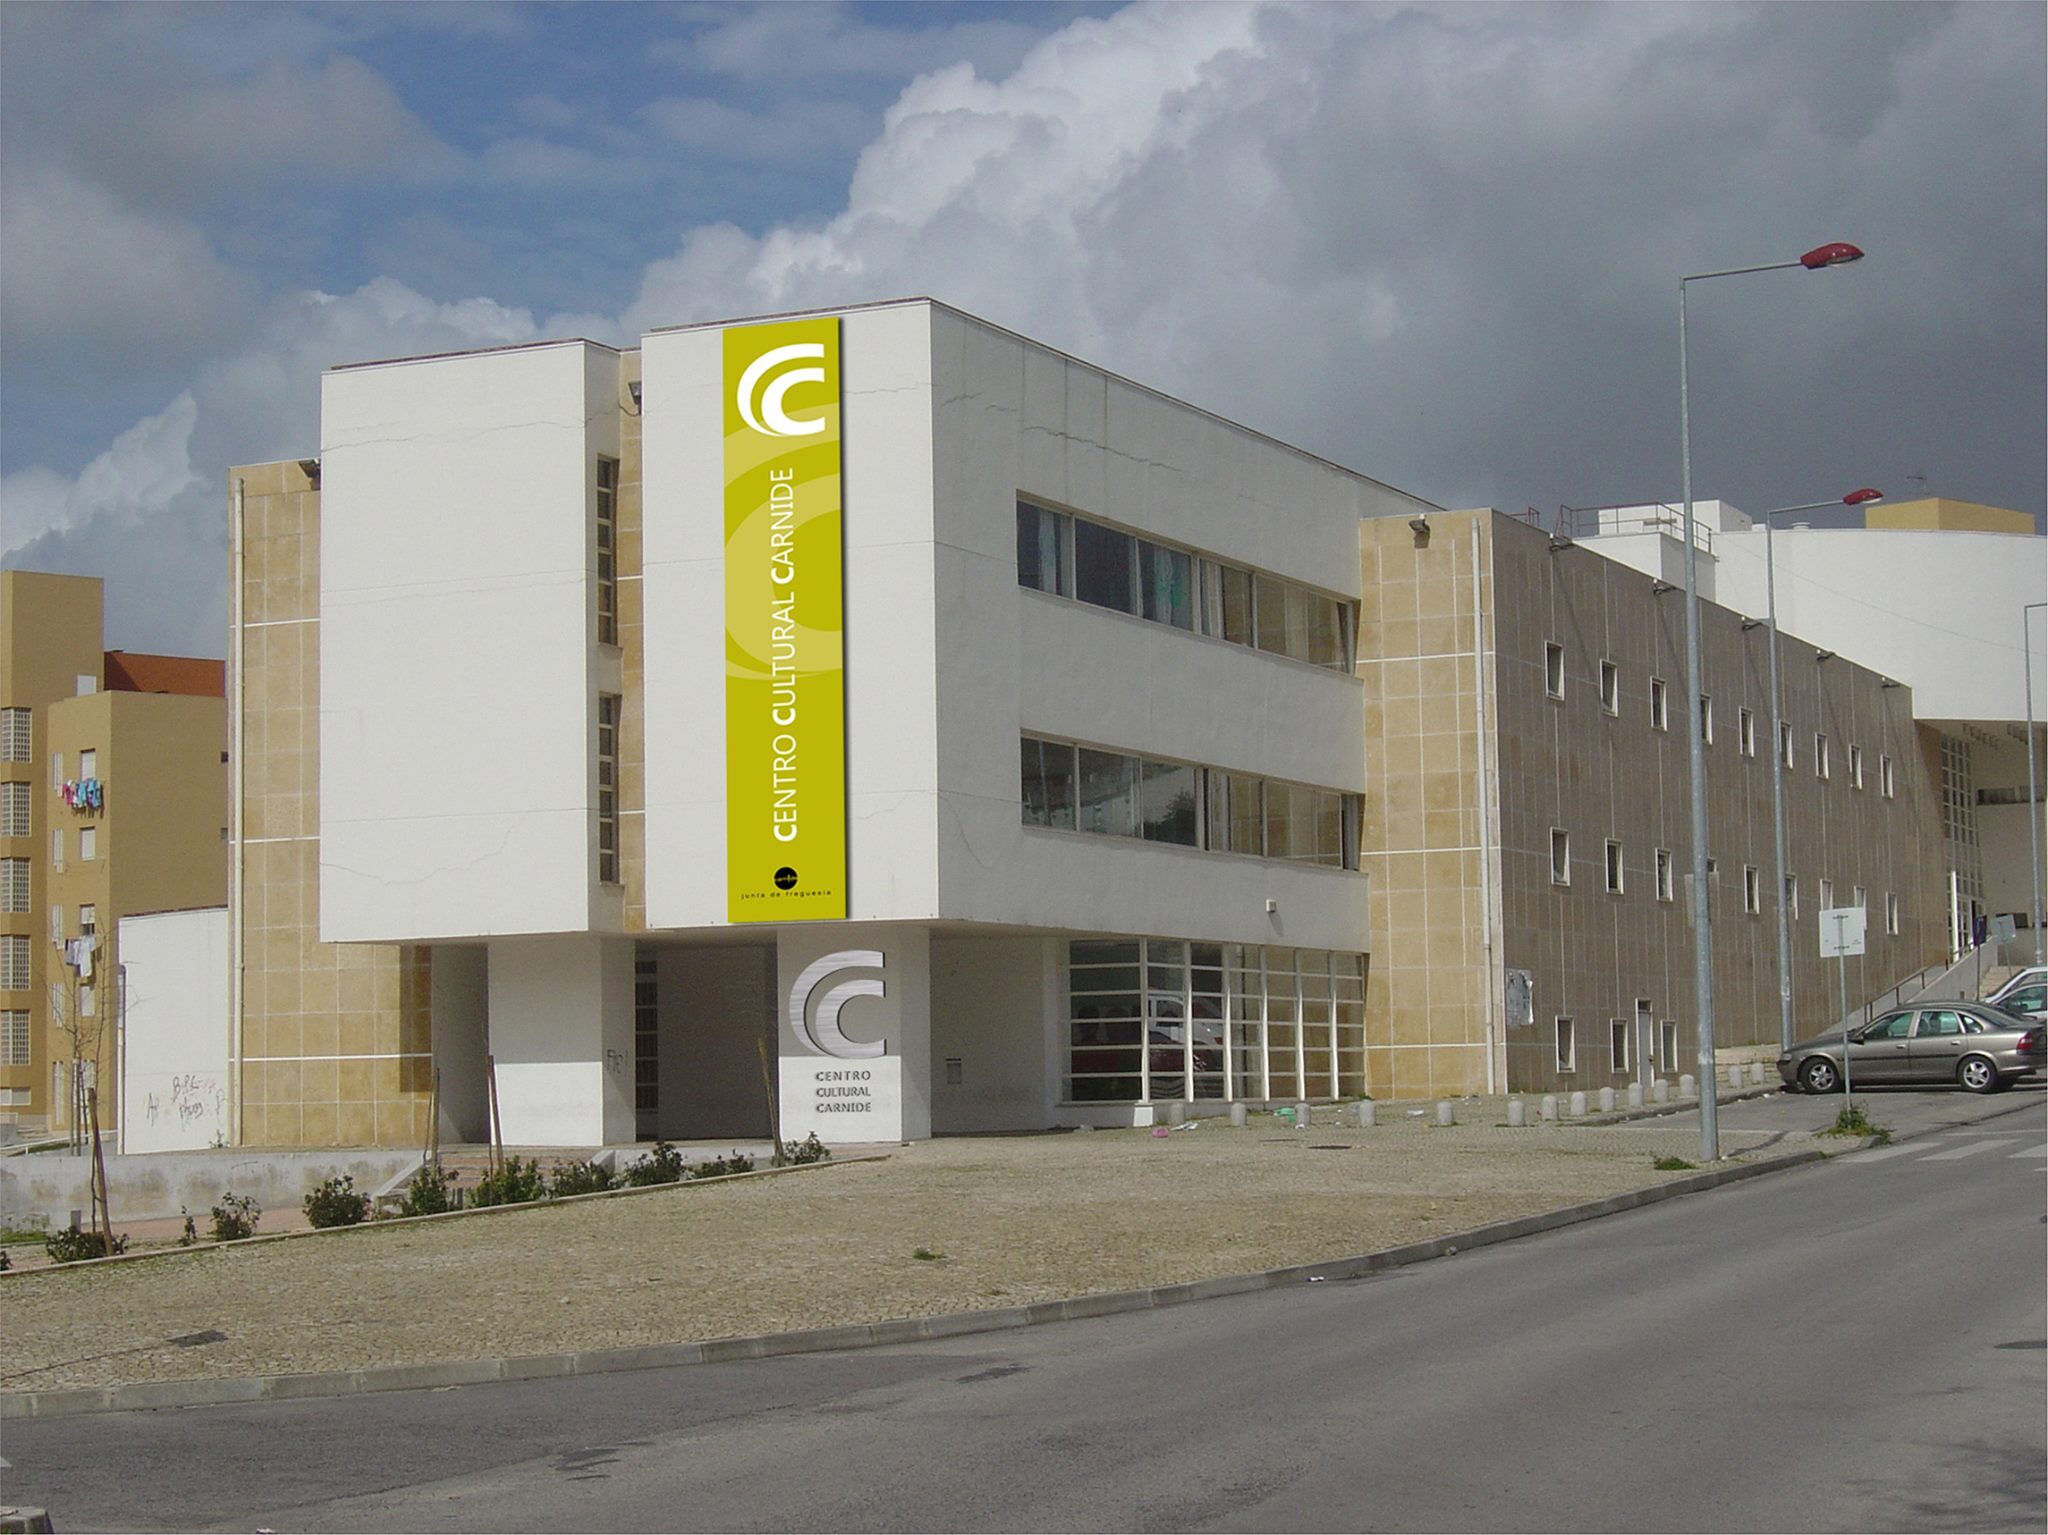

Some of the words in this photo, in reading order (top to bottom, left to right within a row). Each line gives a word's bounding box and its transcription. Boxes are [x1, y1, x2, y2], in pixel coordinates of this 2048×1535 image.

[769, 467, 795, 585] CARNIDE
[771, 591, 796, 726] CULTURAL
[772, 734, 797, 842] CENTRO
[741, 892, 765, 900] junta
[785, 889, 832, 898] freguesia
[815, 1070, 872, 1082] CENTRO
[815, 1086, 872, 1098] CULTURAL
[815, 1102, 872, 1113] CARNIDE
